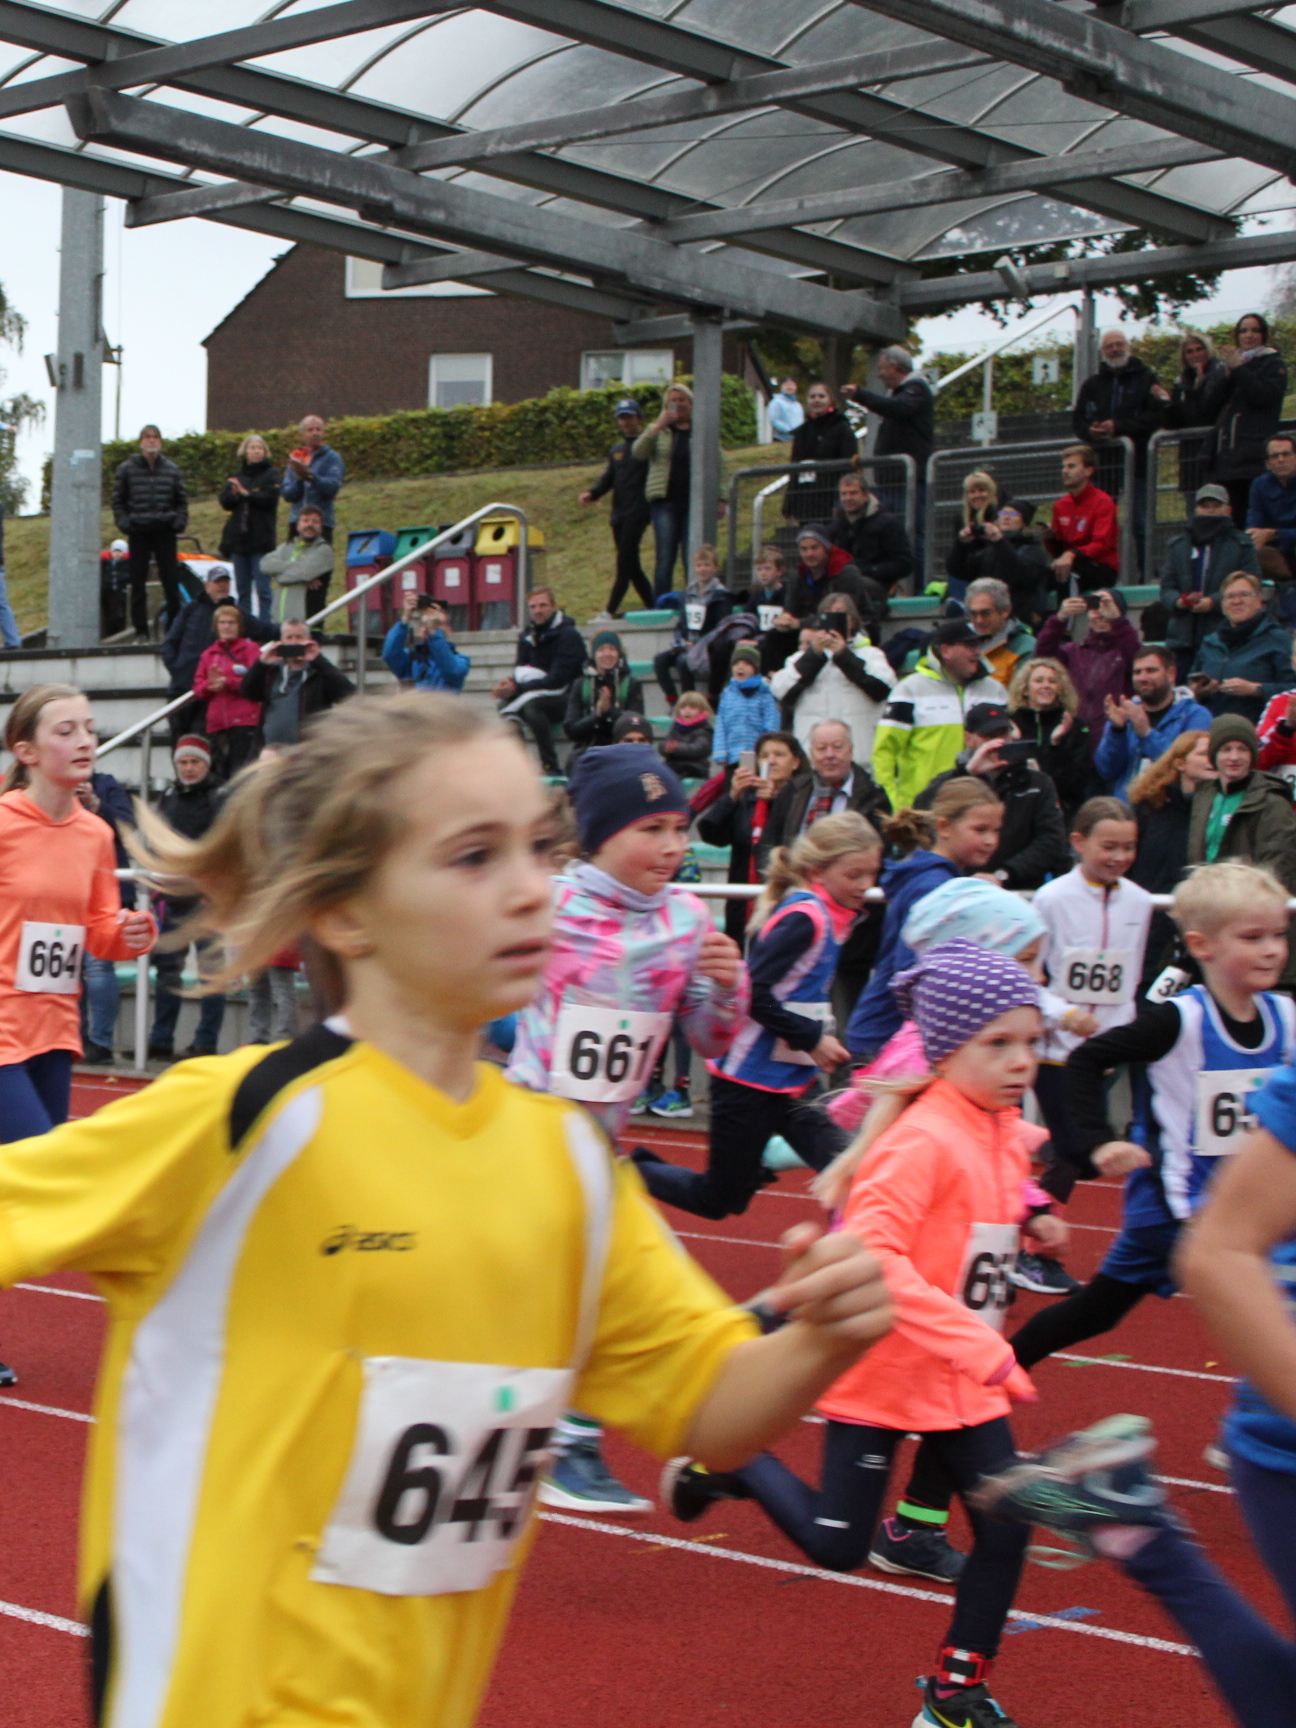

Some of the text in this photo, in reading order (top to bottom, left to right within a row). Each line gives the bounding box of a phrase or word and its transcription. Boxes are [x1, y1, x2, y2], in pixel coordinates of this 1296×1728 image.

[30, 940, 80, 979] 664
[1069, 962, 1123, 993] 668
[570, 1030, 655, 1083] 661
[374, 1422, 554, 1546] 645
